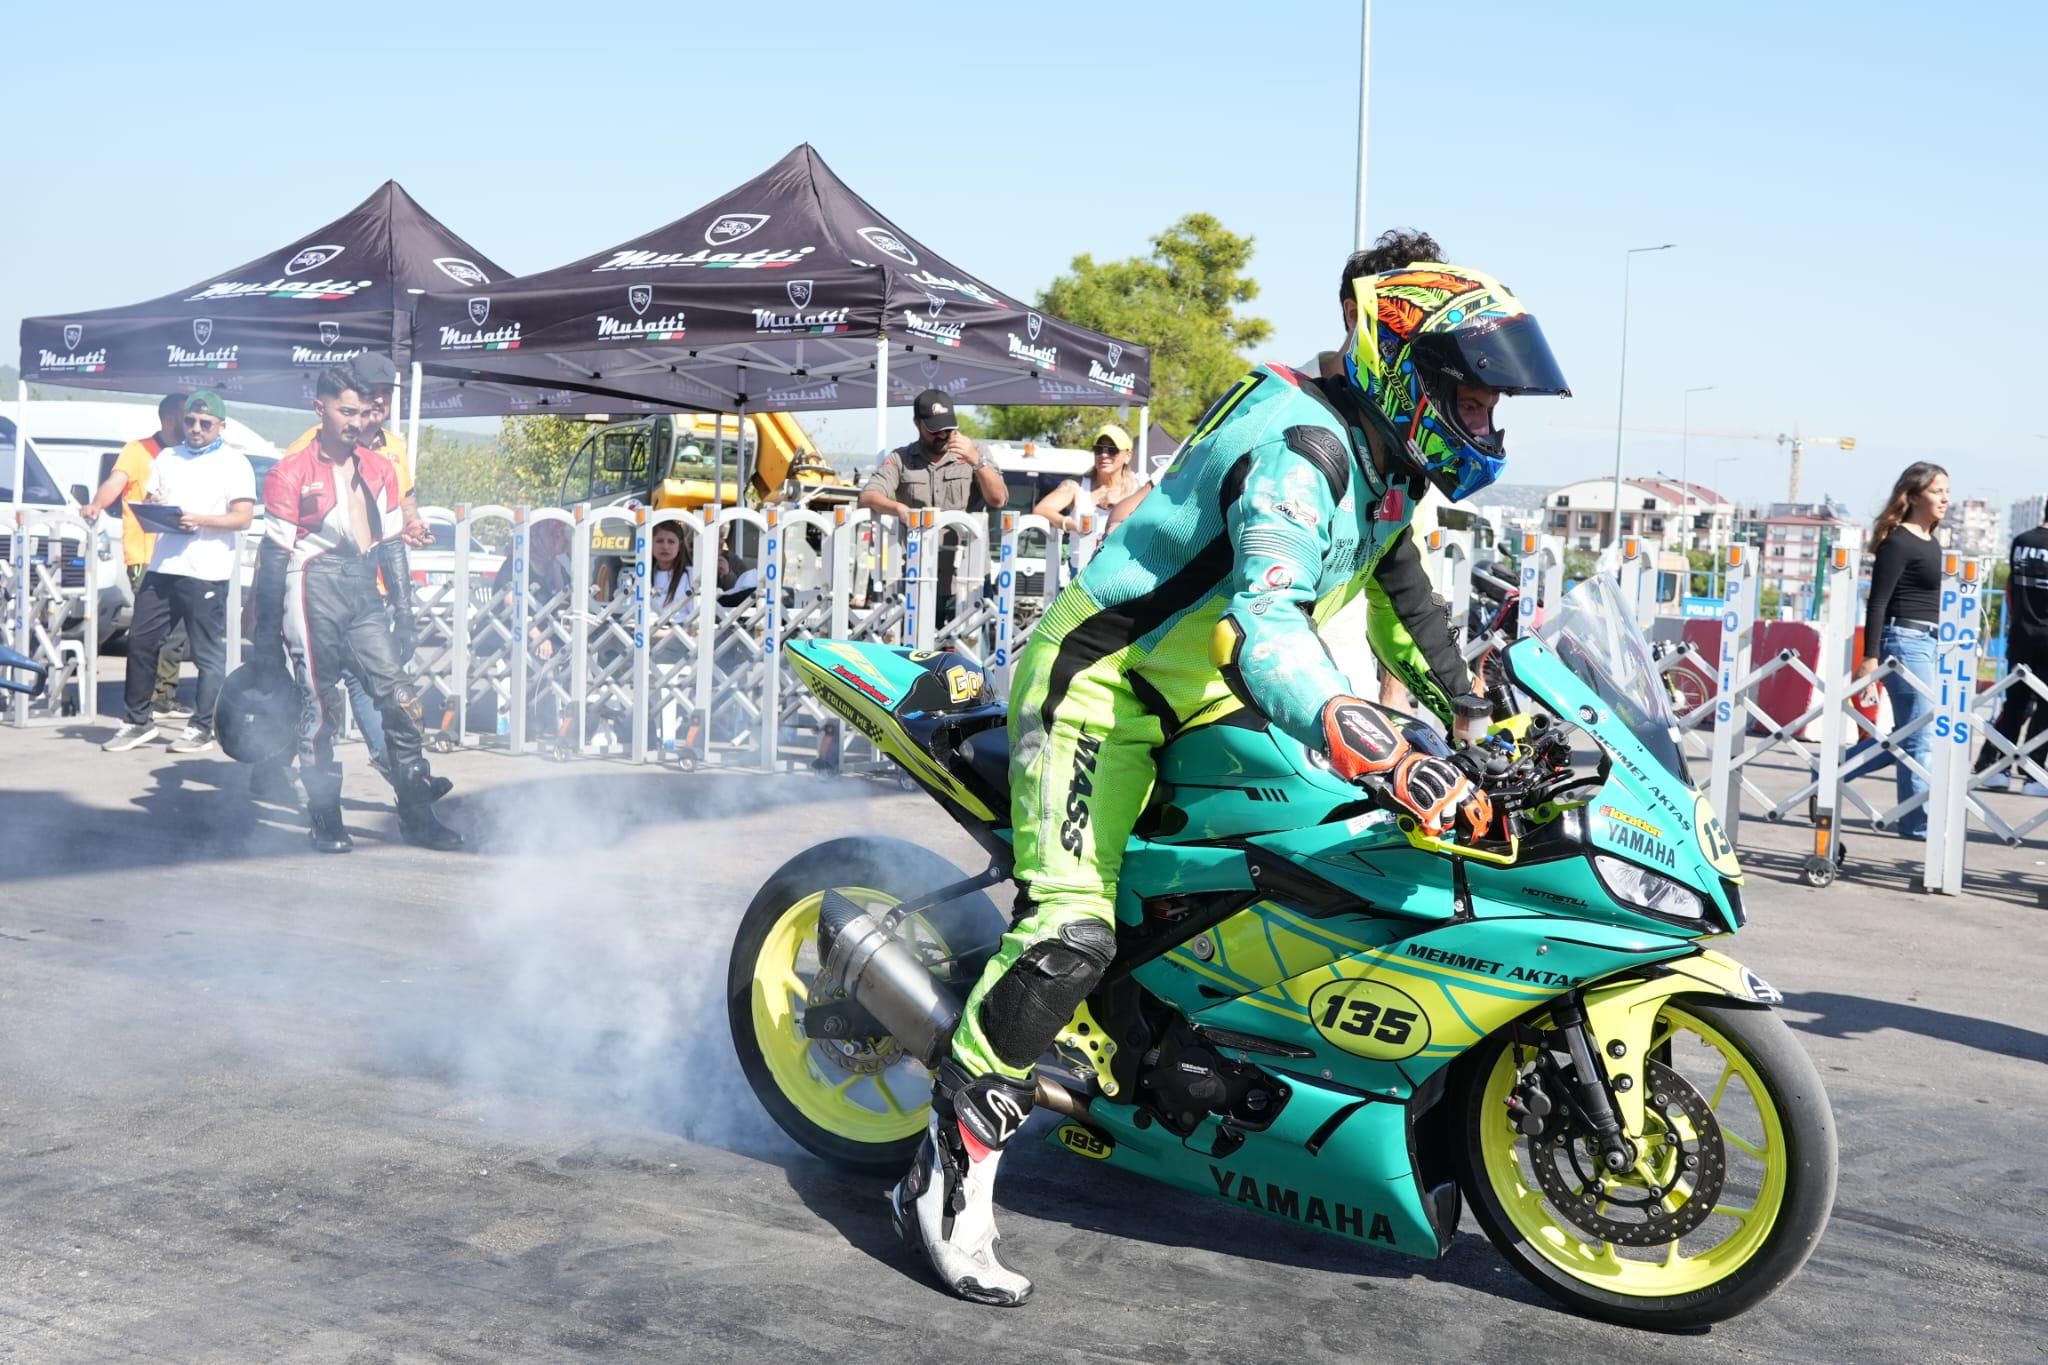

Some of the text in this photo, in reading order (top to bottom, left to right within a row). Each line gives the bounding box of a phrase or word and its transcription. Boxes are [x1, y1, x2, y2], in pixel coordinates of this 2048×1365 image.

[597, 247, 815, 269] Musatti
[192, 278, 372, 299] Musatti
[596, 312, 686, 336] Musatti
[752, 307, 850, 328] Musatti
[904, 310, 965, 339] Musatti
[439, 322, 521, 345] Musatti
[39, 348, 106, 366] Musatti
[167, 344, 238, 363] Musatti
[1008, 333, 1056, 364] Musatti
[1089, 360, 1136, 389] Musatti
[591, 535, 631, 550] DIECI
[904, 542, 919, 649] POLİ
[1959, 583, 1977, 595] 07
[826, 691, 869, 730] FOLLOW ME
[1060, 722, 1101, 862] MASS
[1608, 821, 1676, 869] YAMAHA
[1406, 943, 1505, 975] MEHMET
[1321, 994, 1418, 1045] 135
[1208, 1164, 1397, 1245] YAMAHA
